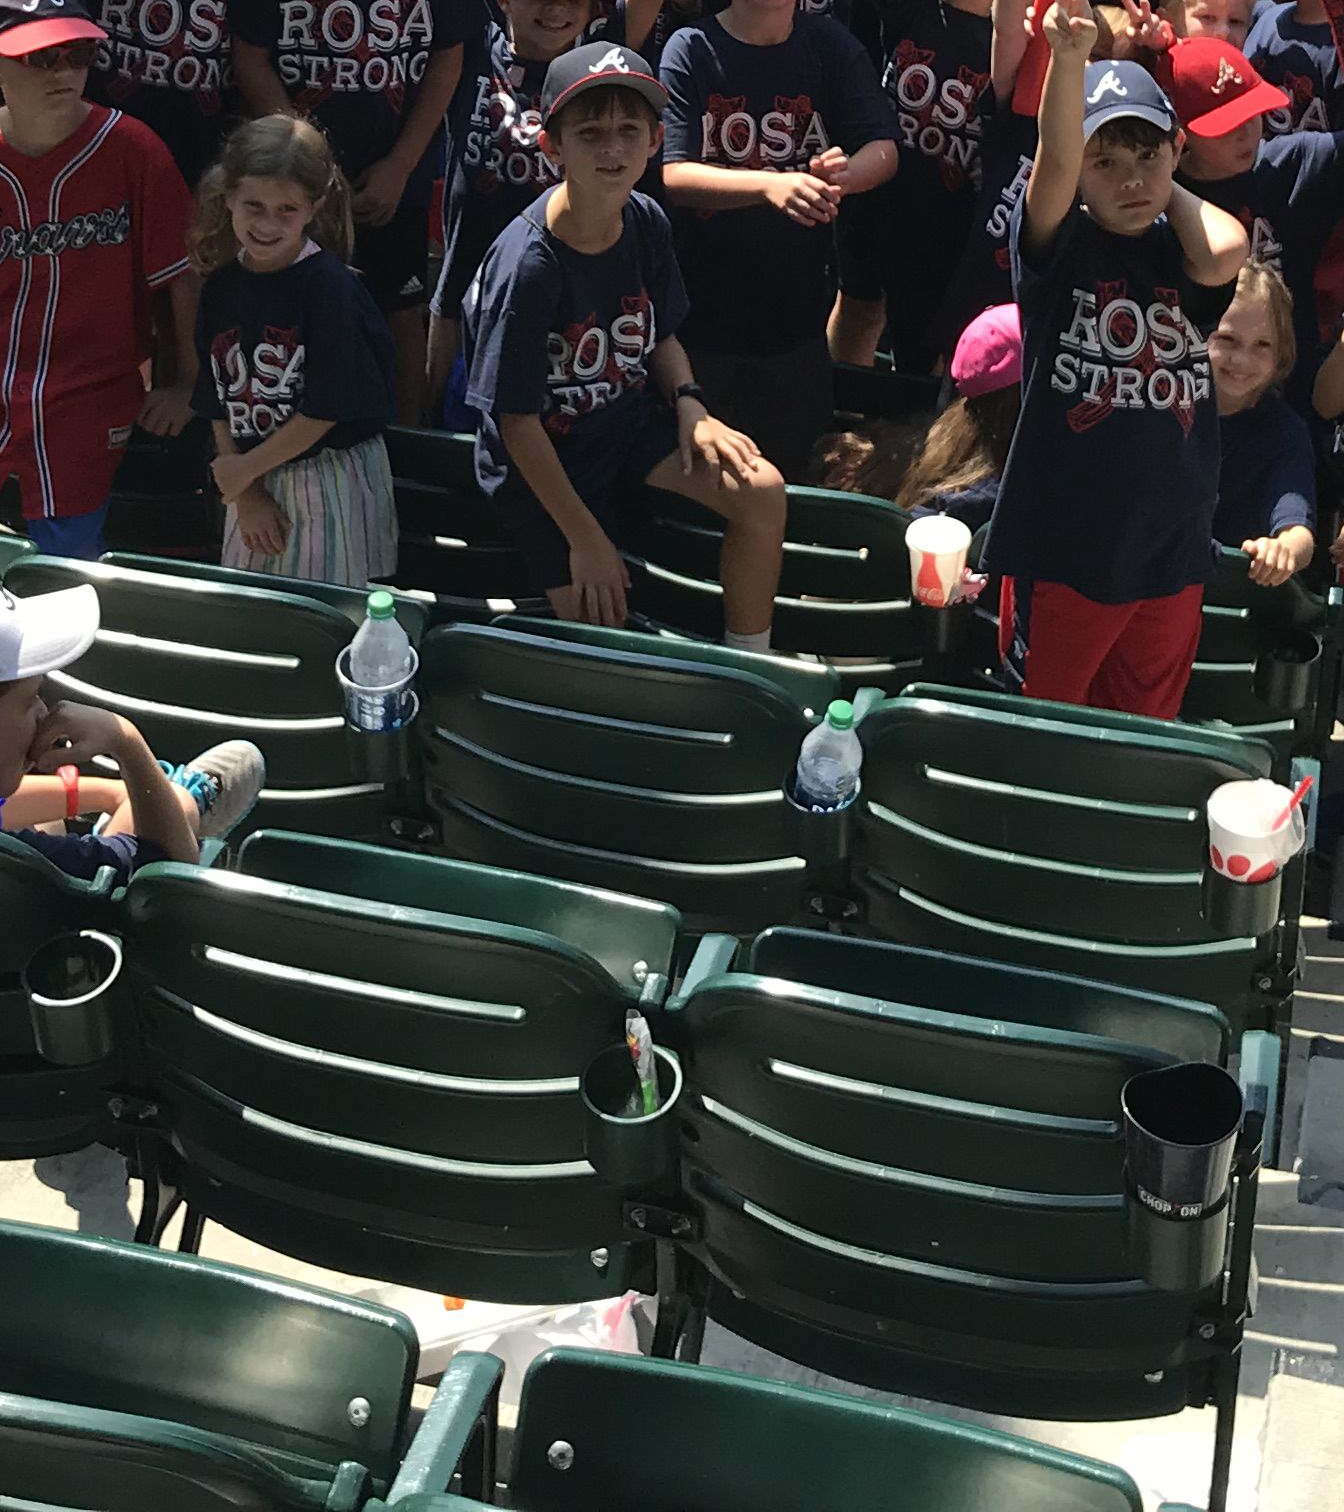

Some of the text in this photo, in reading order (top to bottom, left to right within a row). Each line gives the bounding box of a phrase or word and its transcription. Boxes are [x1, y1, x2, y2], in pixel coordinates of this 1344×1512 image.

[278, 50, 430, 92] STRONG
[588, 46, 630, 74] A
[1211, 57, 1244, 95] A
[1086, 70, 1128, 105] A
